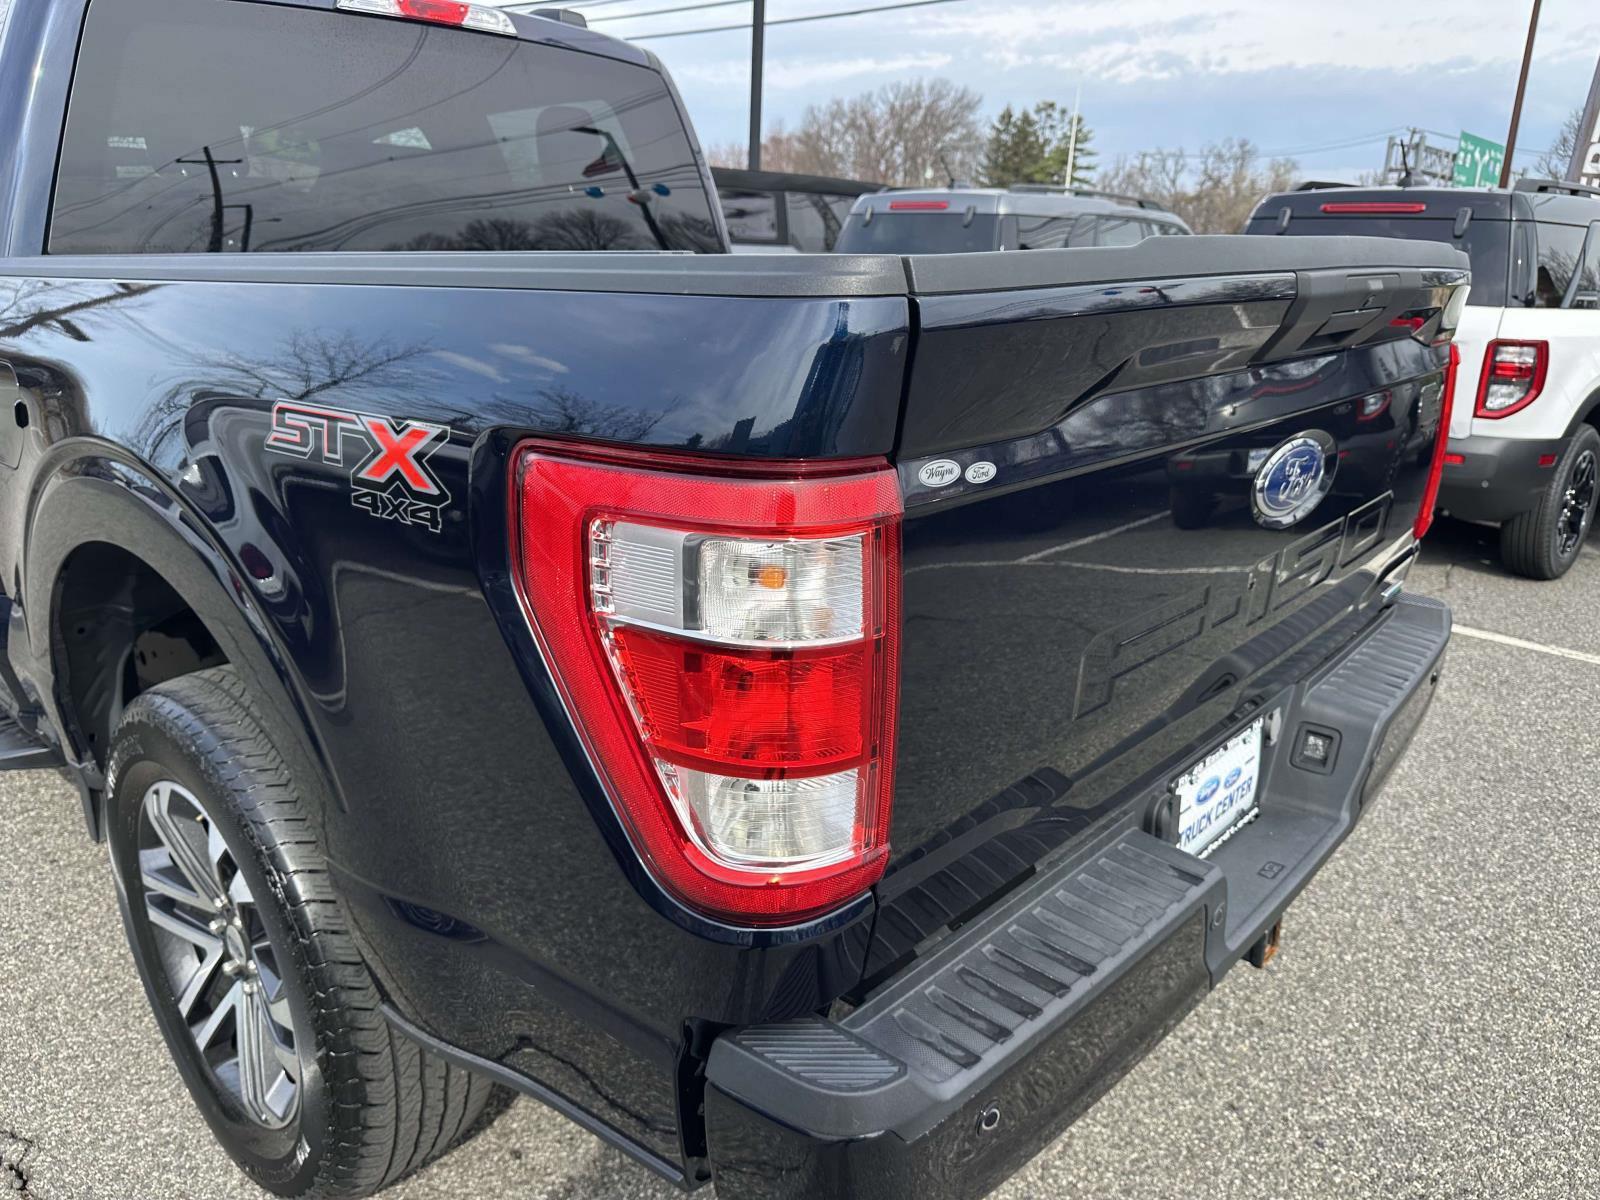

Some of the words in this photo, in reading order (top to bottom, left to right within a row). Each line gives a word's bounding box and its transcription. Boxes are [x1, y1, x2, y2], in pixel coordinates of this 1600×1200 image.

[264, 398, 451, 508] STX
[925, 465, 955, 481] Wayne
[972, 466, 990, 479] Ford
[1278, 455, 1318, 502] Ford
[1180, 808, 1213, 847] TRUCK
[1215, 779, 1253, 819] CENTER
